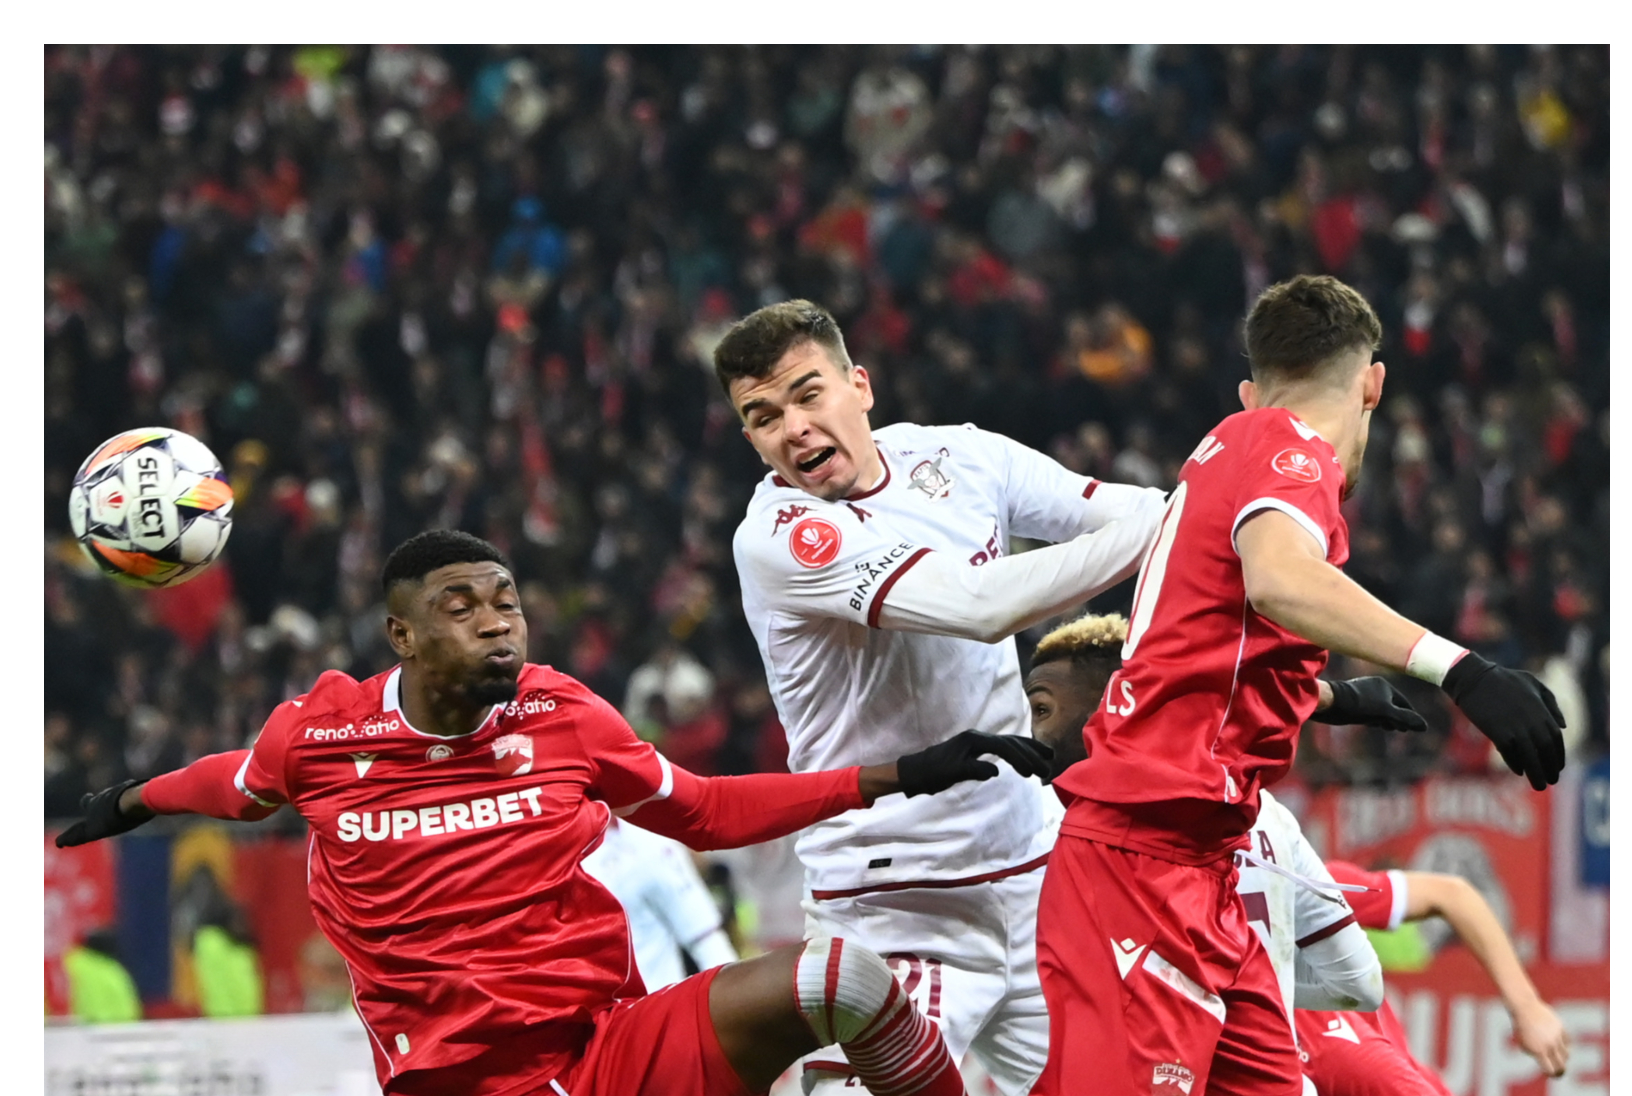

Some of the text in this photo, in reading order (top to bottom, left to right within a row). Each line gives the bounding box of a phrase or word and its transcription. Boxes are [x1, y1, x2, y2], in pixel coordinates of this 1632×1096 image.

[137, 457, 166, 538] SELECT
[849, 541, 915, 612] BINANCE
[336, 786, 544, 843] SUPERBET
